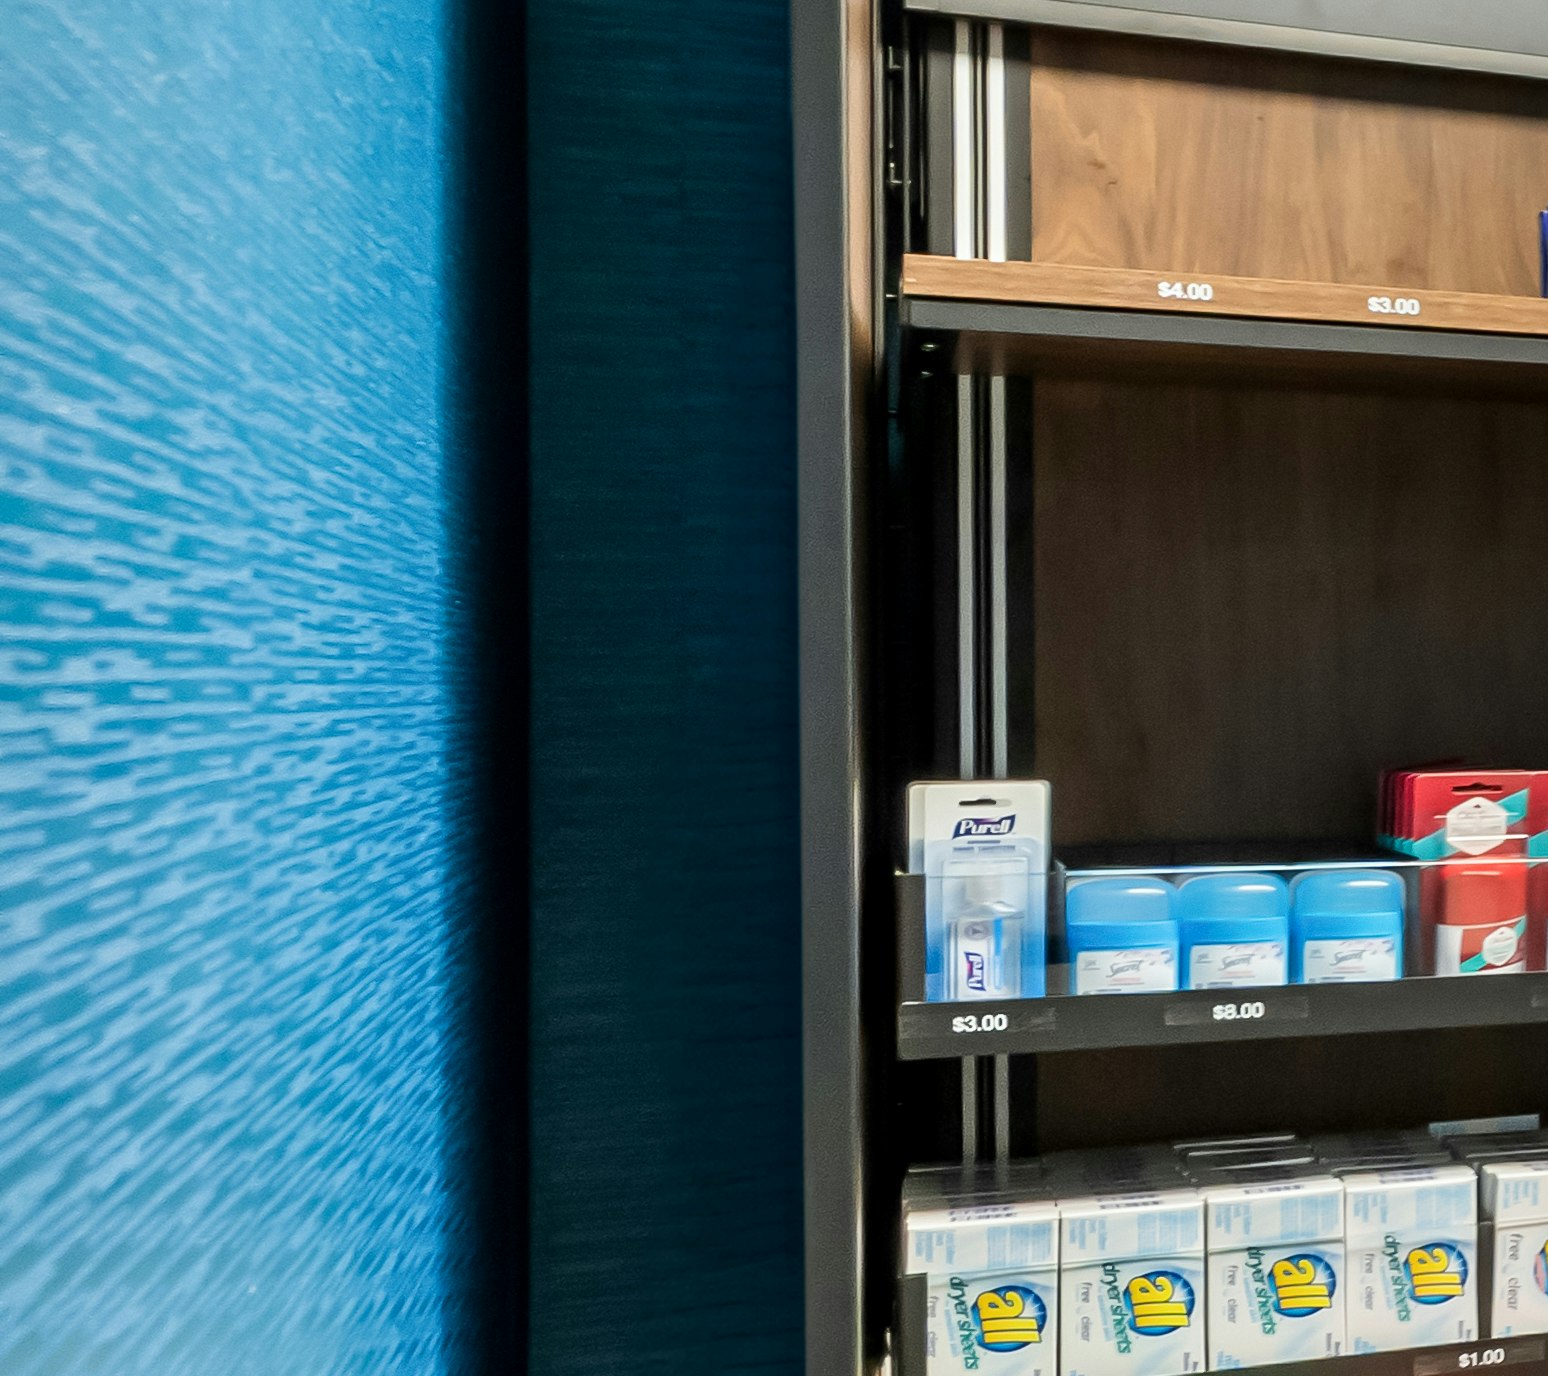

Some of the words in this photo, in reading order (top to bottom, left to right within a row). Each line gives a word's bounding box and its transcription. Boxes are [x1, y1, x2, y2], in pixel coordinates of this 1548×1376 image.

[1158, 280, 1212, 302] $4.00
[1367, 296, 1420, 316] $3.00
[959, 817, 1012, 836] Purell
[1212, 1002, 1265, 1020] $8.00
[952, 1014, 1007, 1033] $3.00
[1459, 1348, 1504, 1367] $1.00
